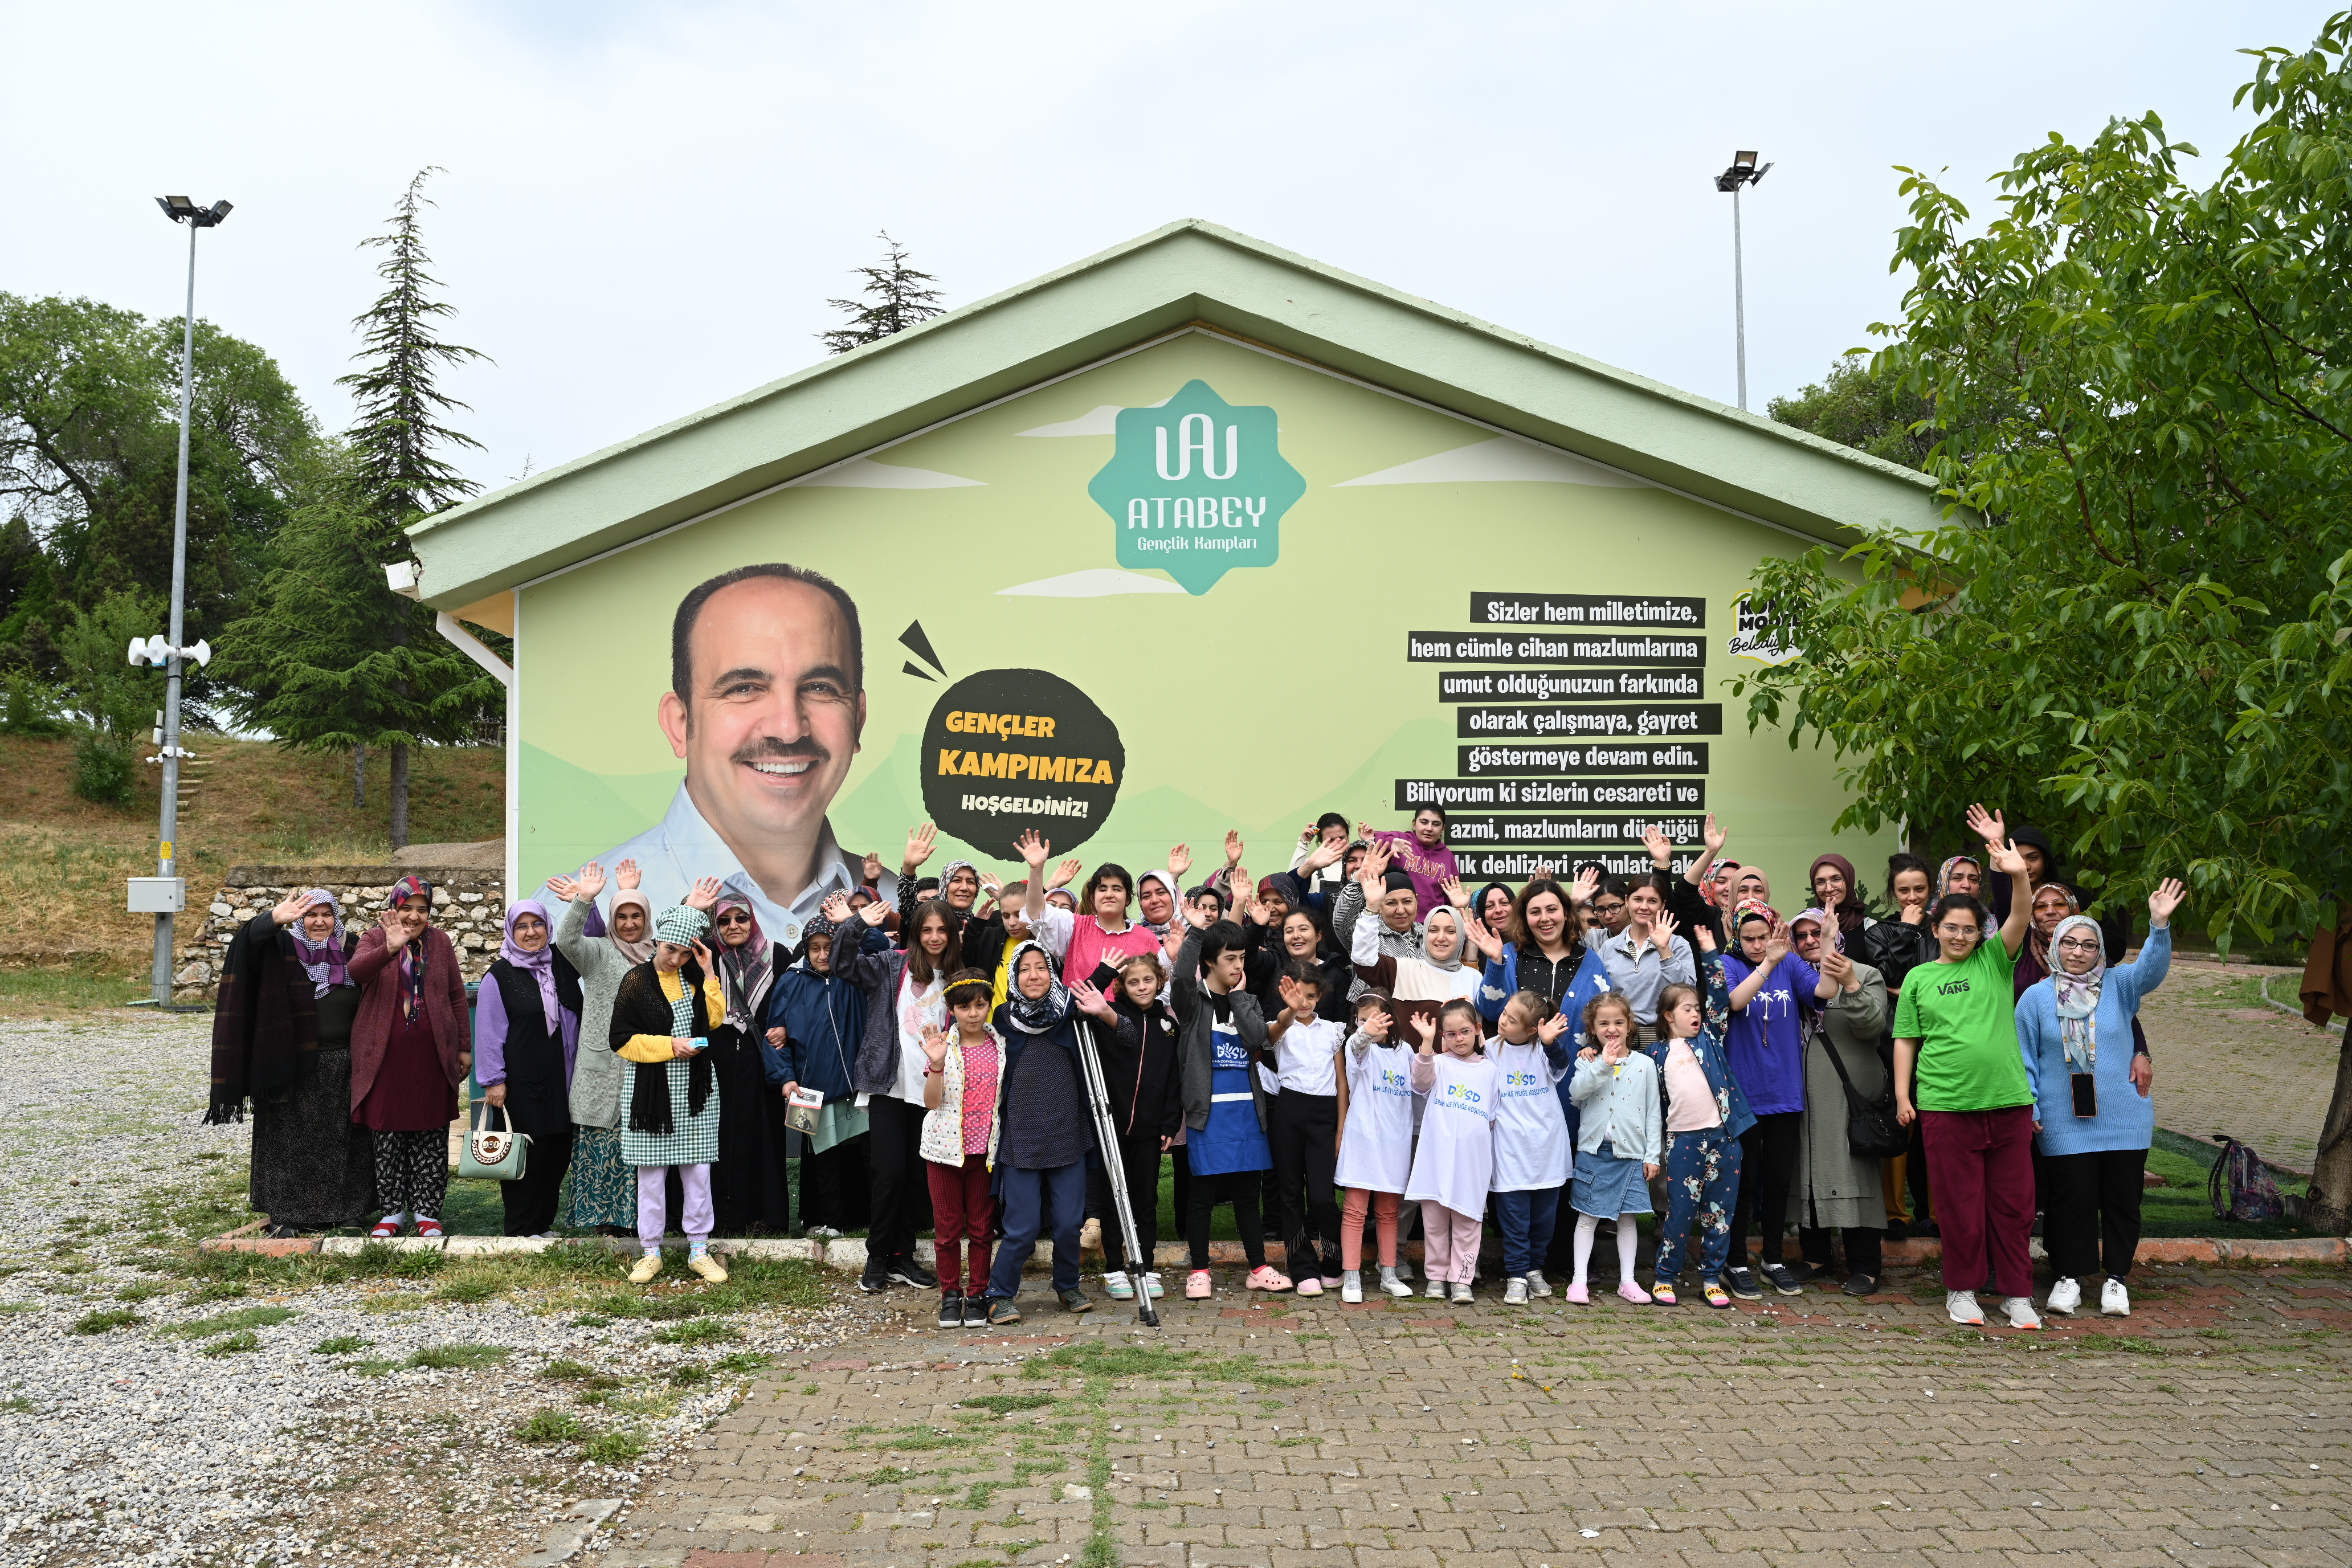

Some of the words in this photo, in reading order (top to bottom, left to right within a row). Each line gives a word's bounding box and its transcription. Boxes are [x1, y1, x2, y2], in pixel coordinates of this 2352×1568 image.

[1128, 496, 1266, 529] ATABEY
[1137, 536, 1189, 554] Gençlik
[1195, 536, 1257, 553] Kampları
[1487, 601, 1540, 622] Sizler
[1544, 602, 1584, 622] hem
[1589, 601, 1697, 623] milletimize,
[1411, 638, 1451, 658] hem
[1456, 638, 1513, 658] cümle
[1518, 636, 1568, 658] cihan
[1574, 637, 1697, 658] mazlumlarına
[1444, 676, 1492, 693] umut
[1497, 673, 1614, 700] olduğunuzun
[1619, 673, 1697, 693] farkında
[945, 710, 1056, 741] GENÇLER
[1469, 710, 1529, 730] olarak
[1533, 710, 1632, 735] çalışmaya,
[1637, 710, 1698, 736] gayret
[938, 749, 1114, 785] KAMPIMIZA
[1468, 746, 1581, 772] göstermeye
[1585, 746, 1647, 766] devam
[1652, 746, 1698, 766] edin.
[961, 794, 1089, 818] HOŞGELDİNİZ!
[1407, 781, 1494, 807] Biliyorum
[1499, 781, 1516, 802] ki
[1521, 782, 1589, 802] sizlerin
[1593, 781, 1672, 802] cesareti
[1676, 787, 1698, 802] ve
[1450, 818, 1500, 840] azmi,
[1504, 818, 1618, 839] mazlumların
[1403, 855, 1446, 885] MAVİ
[1481, 854, 1568, 875] dehlizleri
[1937, 978, 1970, 995] VANS
[1452, 1100, 1468, 1110] İYİLİĞE
[1467, 1105, 1489, 1120] KOŞUYORU
